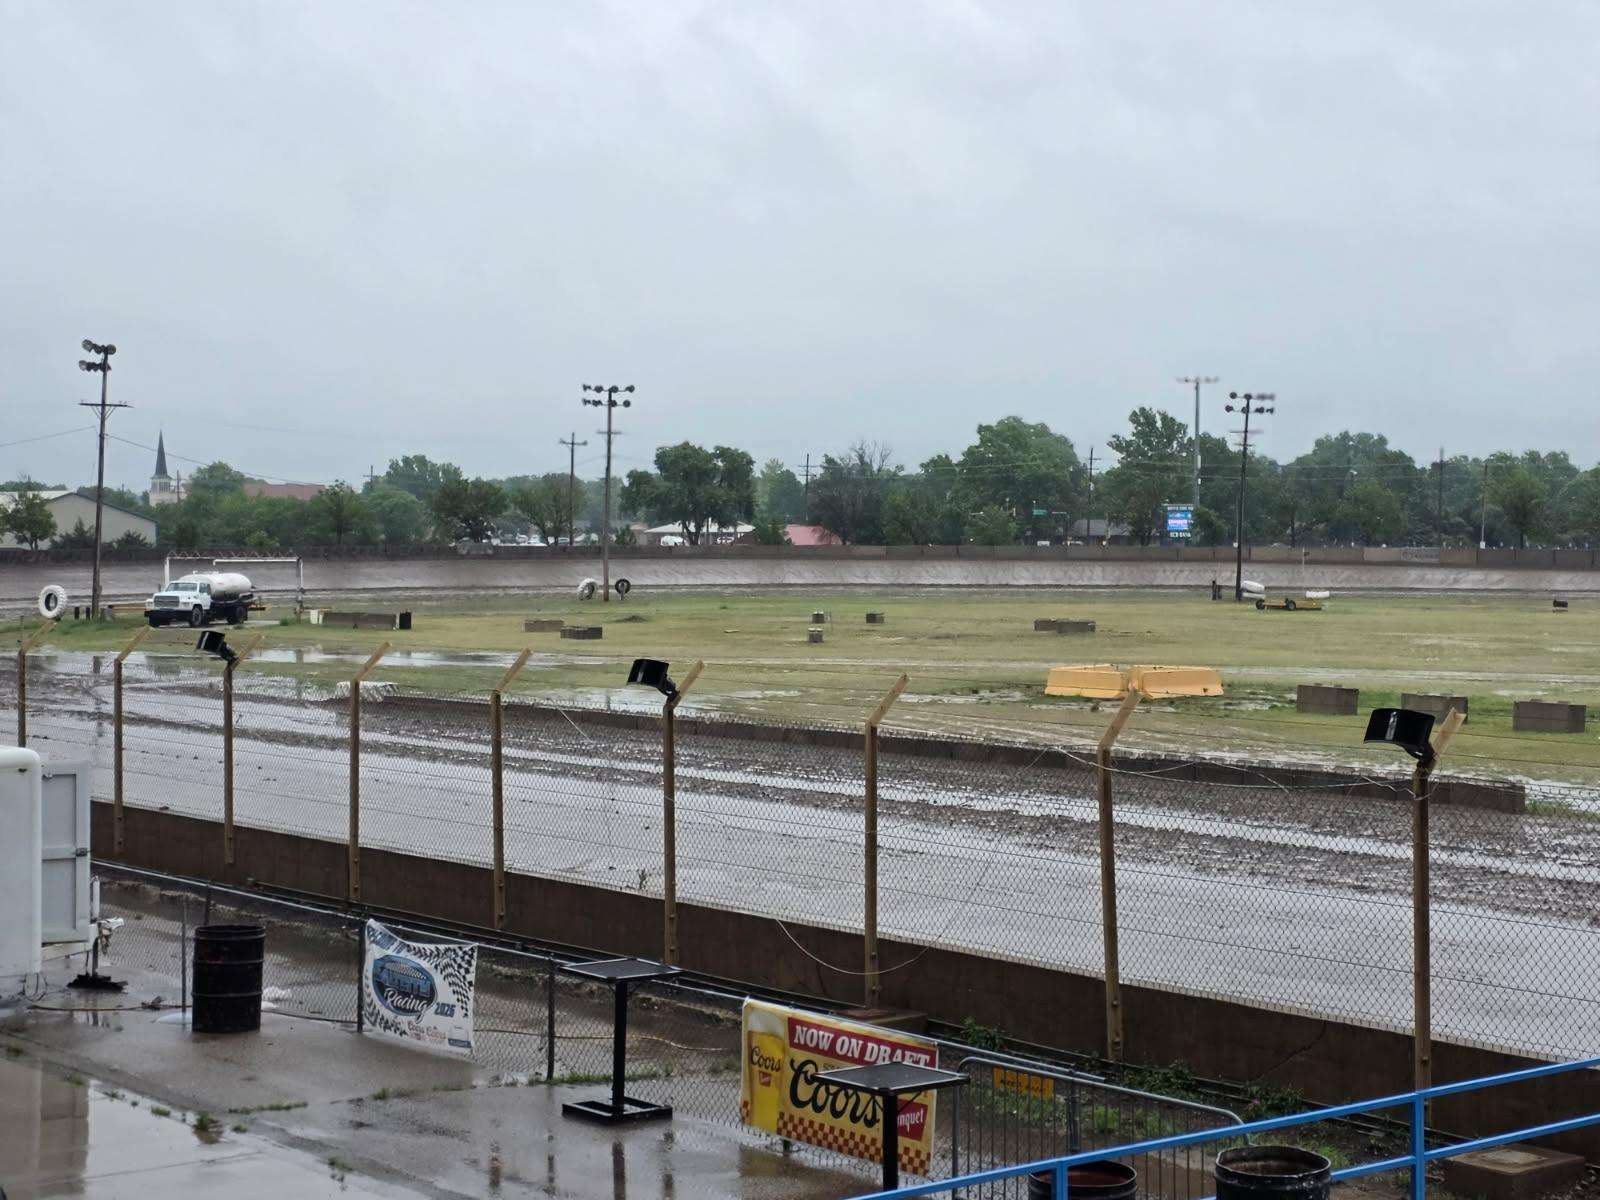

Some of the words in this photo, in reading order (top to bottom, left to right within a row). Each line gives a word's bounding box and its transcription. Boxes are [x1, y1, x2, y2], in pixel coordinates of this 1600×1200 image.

[384, 987, 428, 1024] Racing
[751, 1045, 781, 1072] Coors
[794, 1025, 835, 1051] NOW
[836, 1036, 860, 1059] ON
[864, 1044, 930, 1067] DRAFT
[789, 1058, 880, 1128] Coors
